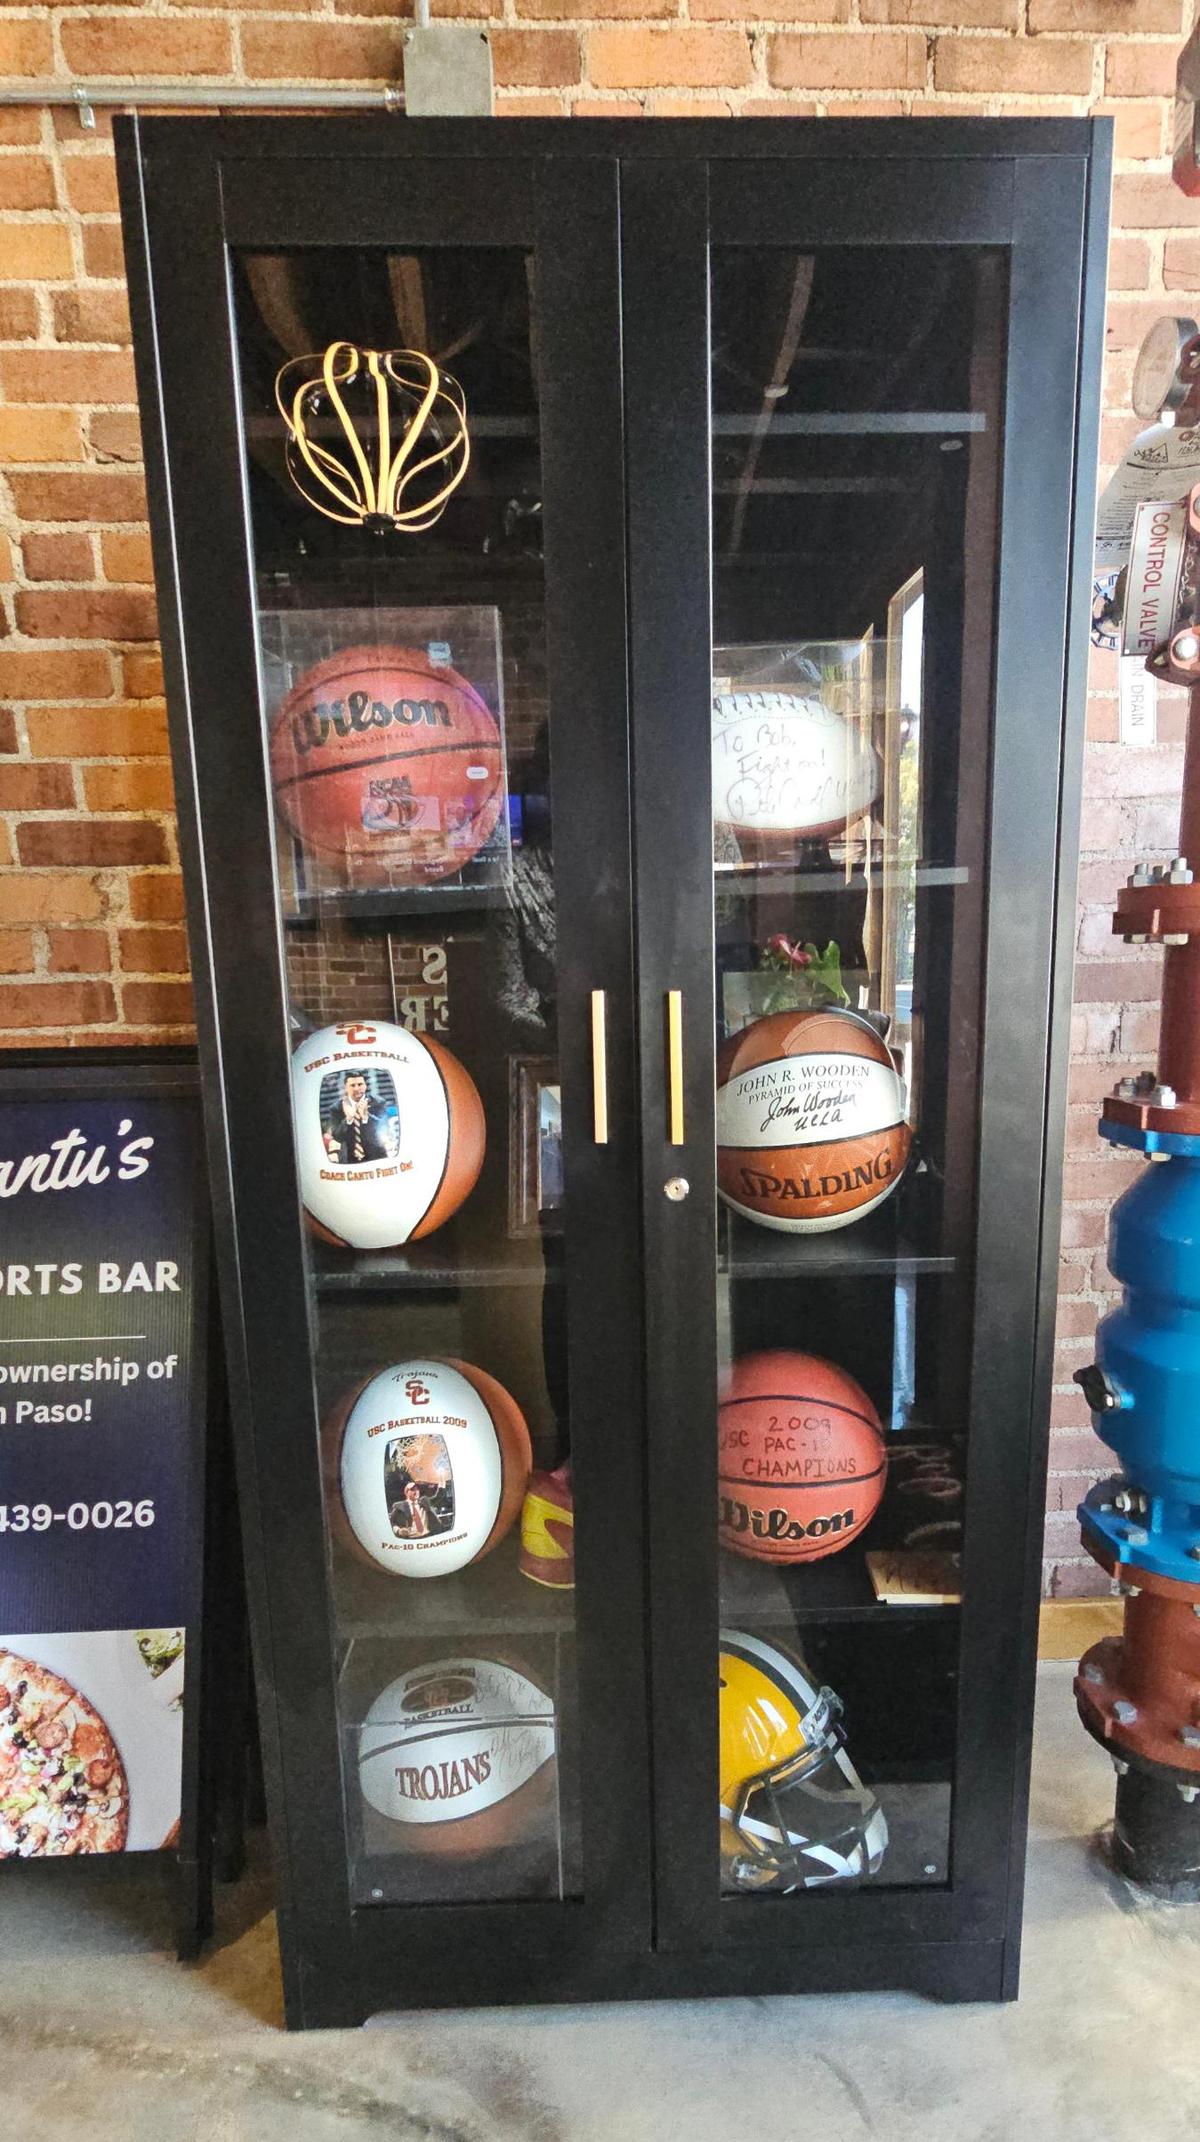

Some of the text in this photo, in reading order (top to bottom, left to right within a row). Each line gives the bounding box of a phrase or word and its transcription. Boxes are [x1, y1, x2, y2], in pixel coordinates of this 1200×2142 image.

[1137, 511, 1170, 649] CONTROL VALVE
[1129, 684, 1145, 727] DRAIN
[292, 690, 452, 755] Wilson
[304, 1050, 410, 1073] USC BASKETBALL
[736, 1064, 870, 1096] JOHN R. WOODEN
[748, 1085, 796, 1105] PYRAMID
[798, 1081, 814, 1092] OF
[760, 1096, 800, 1132] John
[740, 1147, 893, 1200] SPALDING
[0, 1261, 181, 1296] RTS BAR
[147, 1354, 178, 1379] of
[16, 1399, 92, 1424] Paso!
[367, 1415, 468, 1438] USC BASKETBALL 2009
[768, 1416, 832, 1434] 2009
[742, 1457, 857, 1477] CHAMPIONS
[394, 1750, 492, 1801] TROJANS
